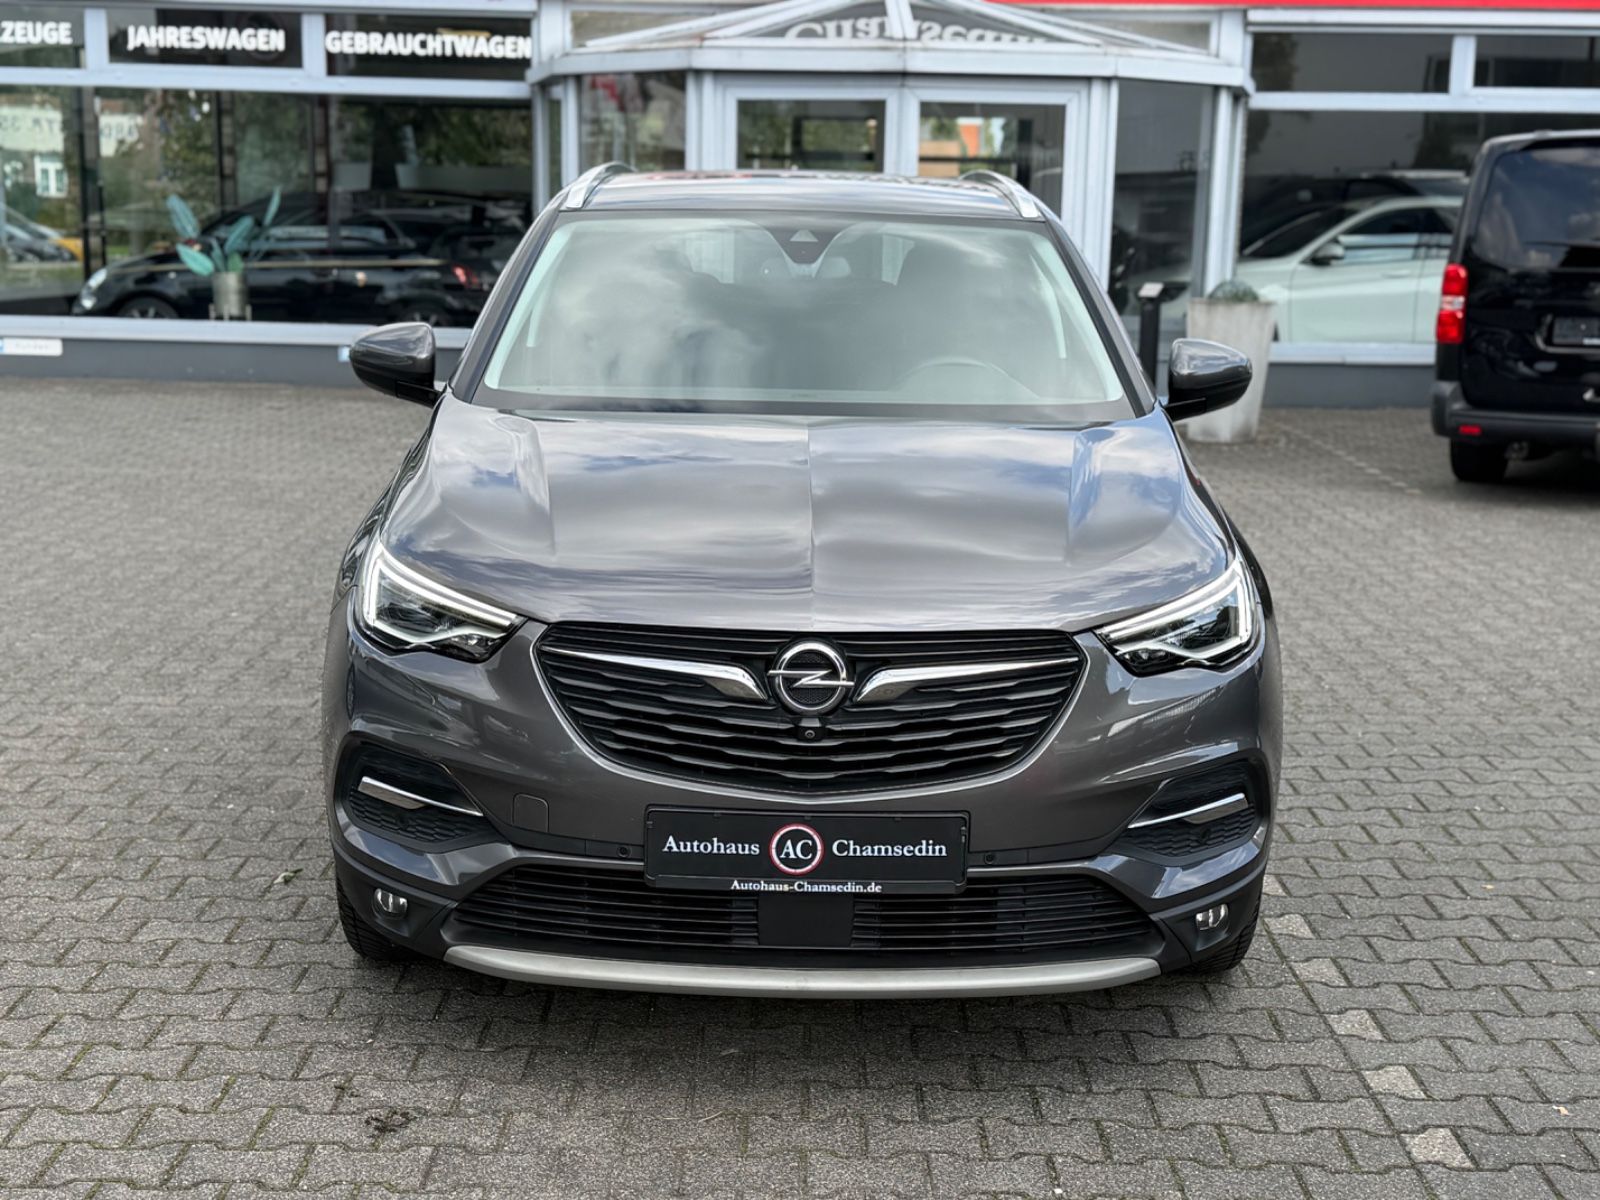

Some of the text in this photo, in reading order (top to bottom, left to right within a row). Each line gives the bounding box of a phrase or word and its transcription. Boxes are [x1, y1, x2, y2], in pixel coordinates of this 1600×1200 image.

[126, 24, 286, 52] JAHRESWAGEN
[325, 31, 532, 59] GEBRAUCHTWAGEN
[662, 835, 948, 860] Autohaus AC Chamsedin
[730, 879, 883, 893] Autohaus-Chamsedin.de
